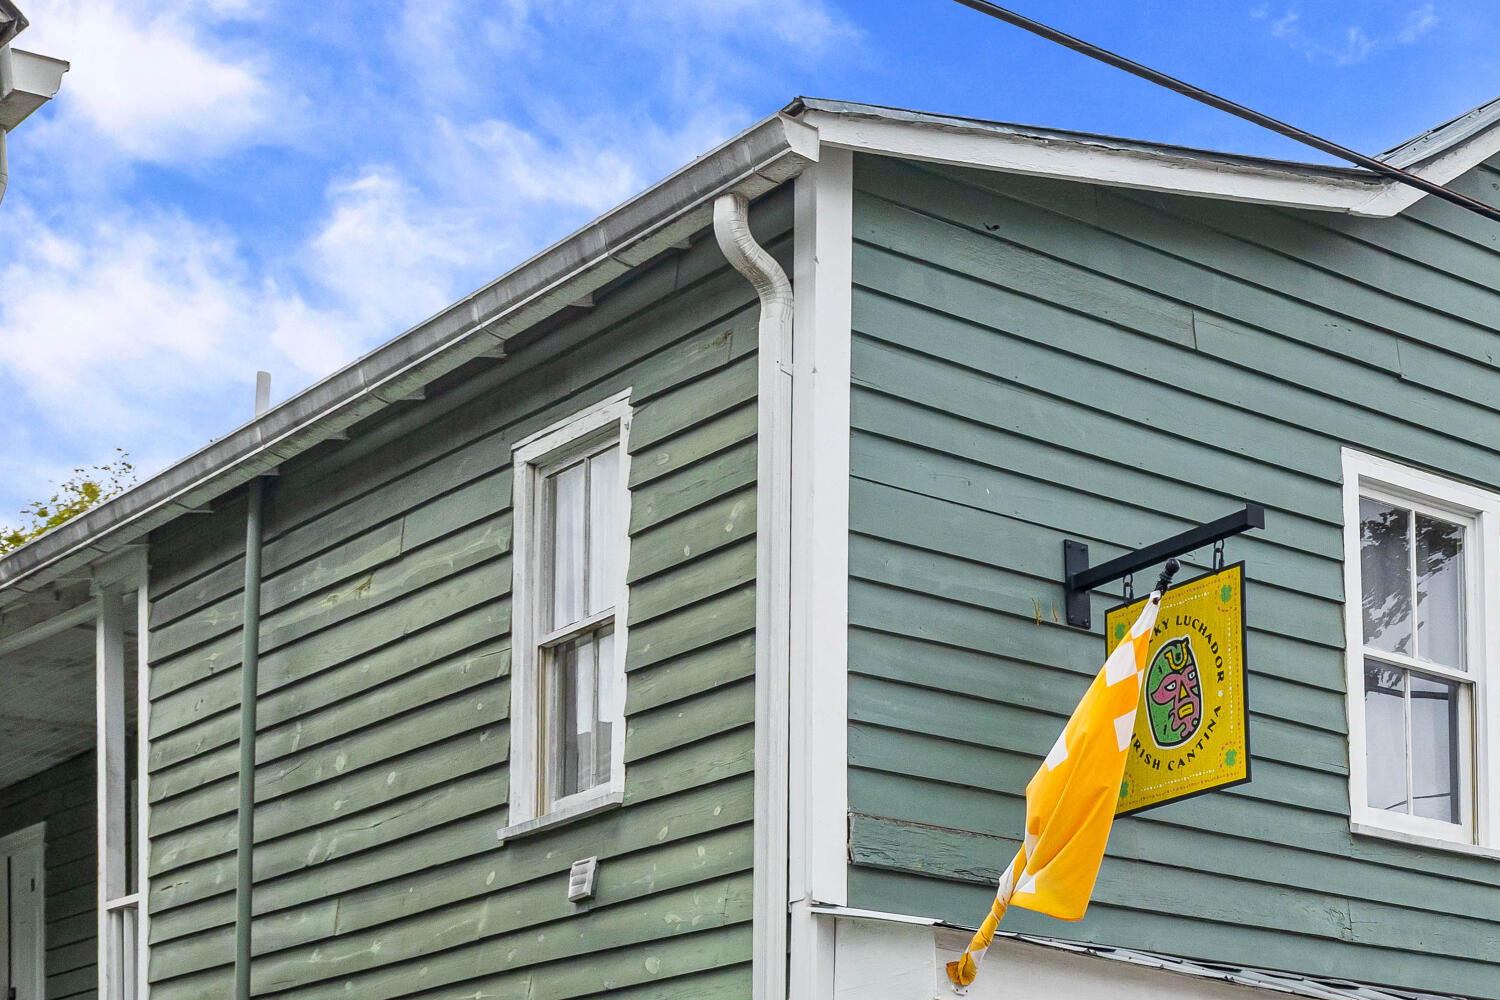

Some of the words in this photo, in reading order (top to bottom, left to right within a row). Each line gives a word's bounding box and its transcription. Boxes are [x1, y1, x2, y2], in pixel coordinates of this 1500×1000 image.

[1176, 615, 1225, 684] LUCHADOR
[1132, 733, 1161, 771] IRISH
[1168, 705, 1222, 771] CANTINA
